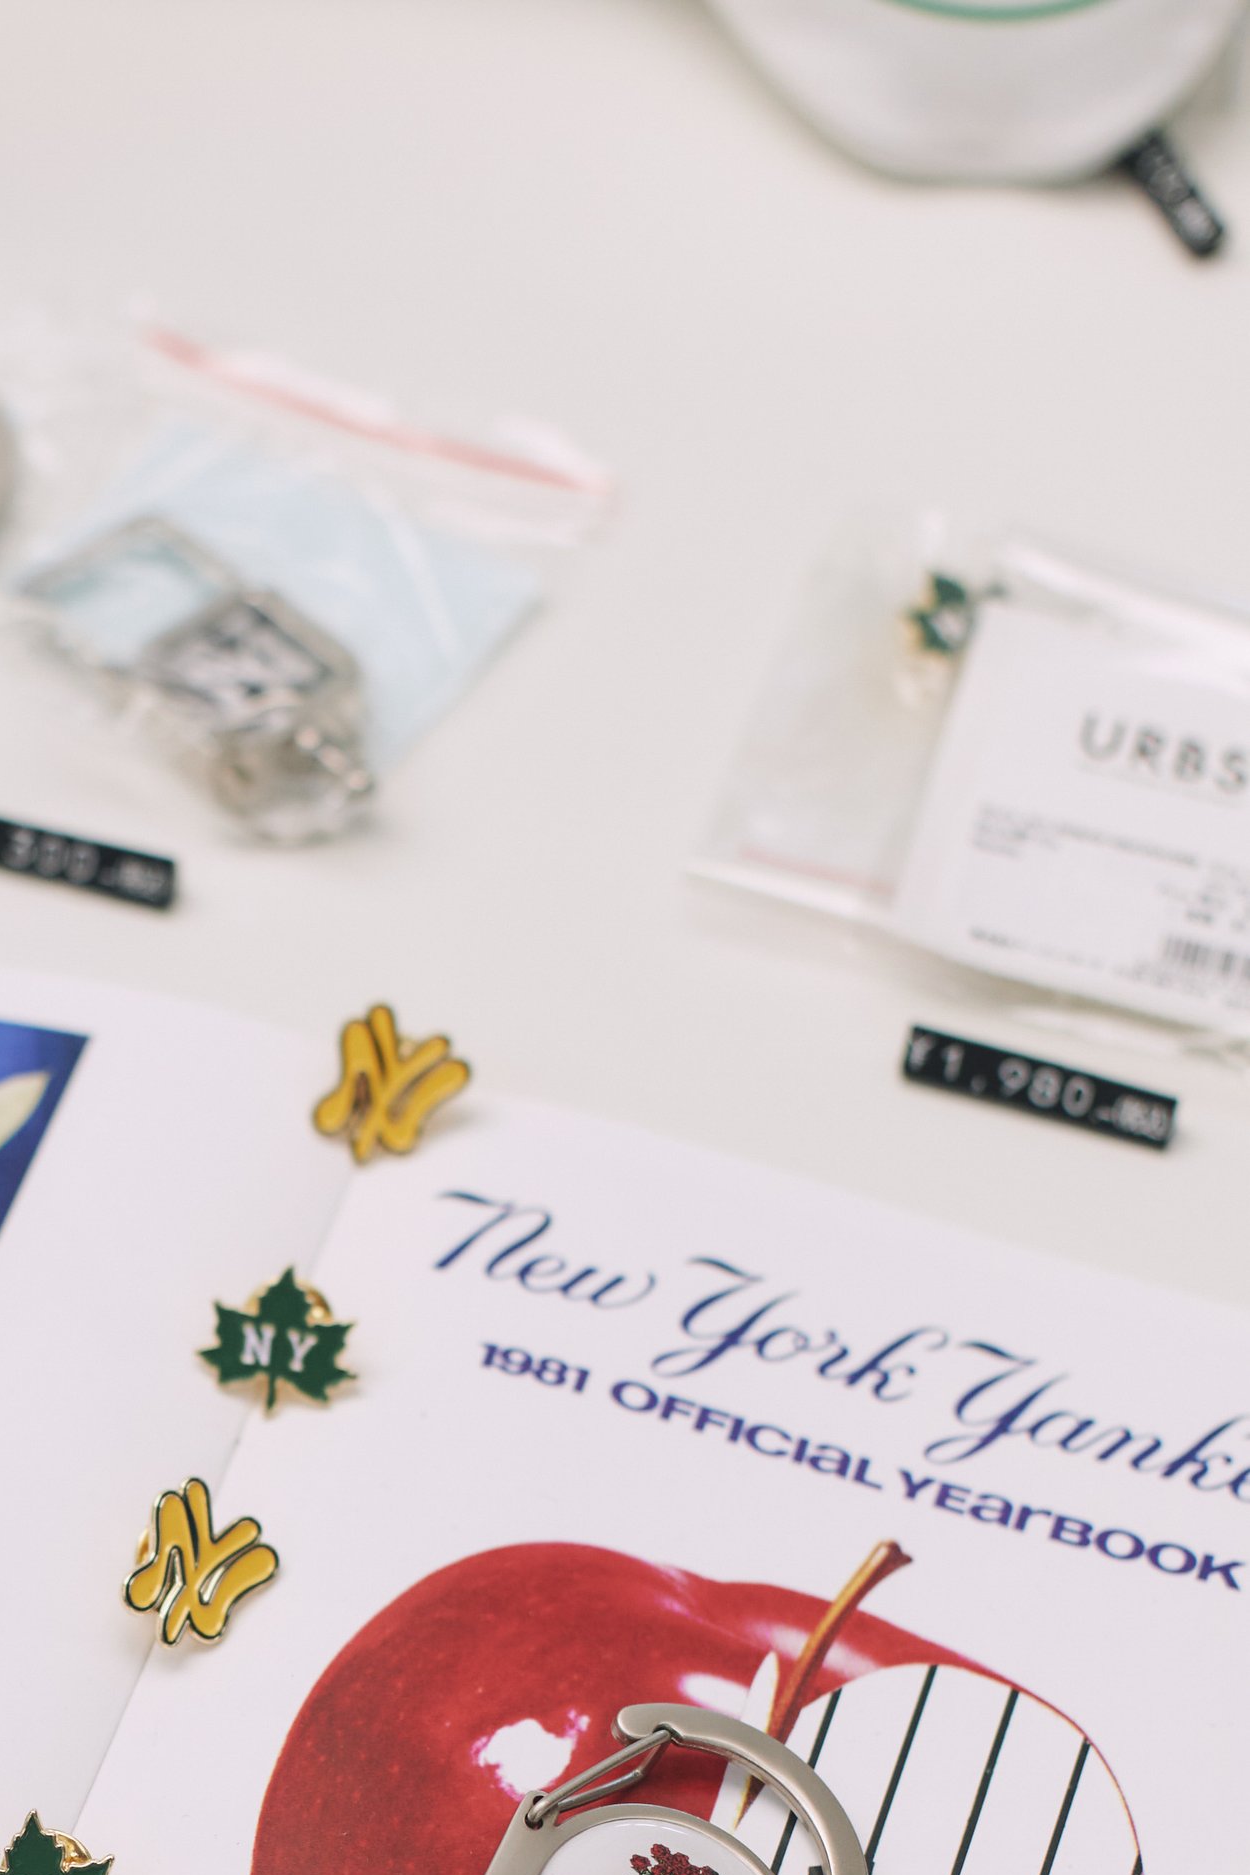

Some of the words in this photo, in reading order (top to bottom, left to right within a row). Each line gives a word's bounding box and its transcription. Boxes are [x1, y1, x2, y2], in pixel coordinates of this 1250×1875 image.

[1079, 710, 1248, 795] URBS
[433, 1191, 657, 1310] New
[651, 1256, 949, 1403] York
[241, 1323, 318, 1373] NY
[478, 1342, 590, 1394] 1981
